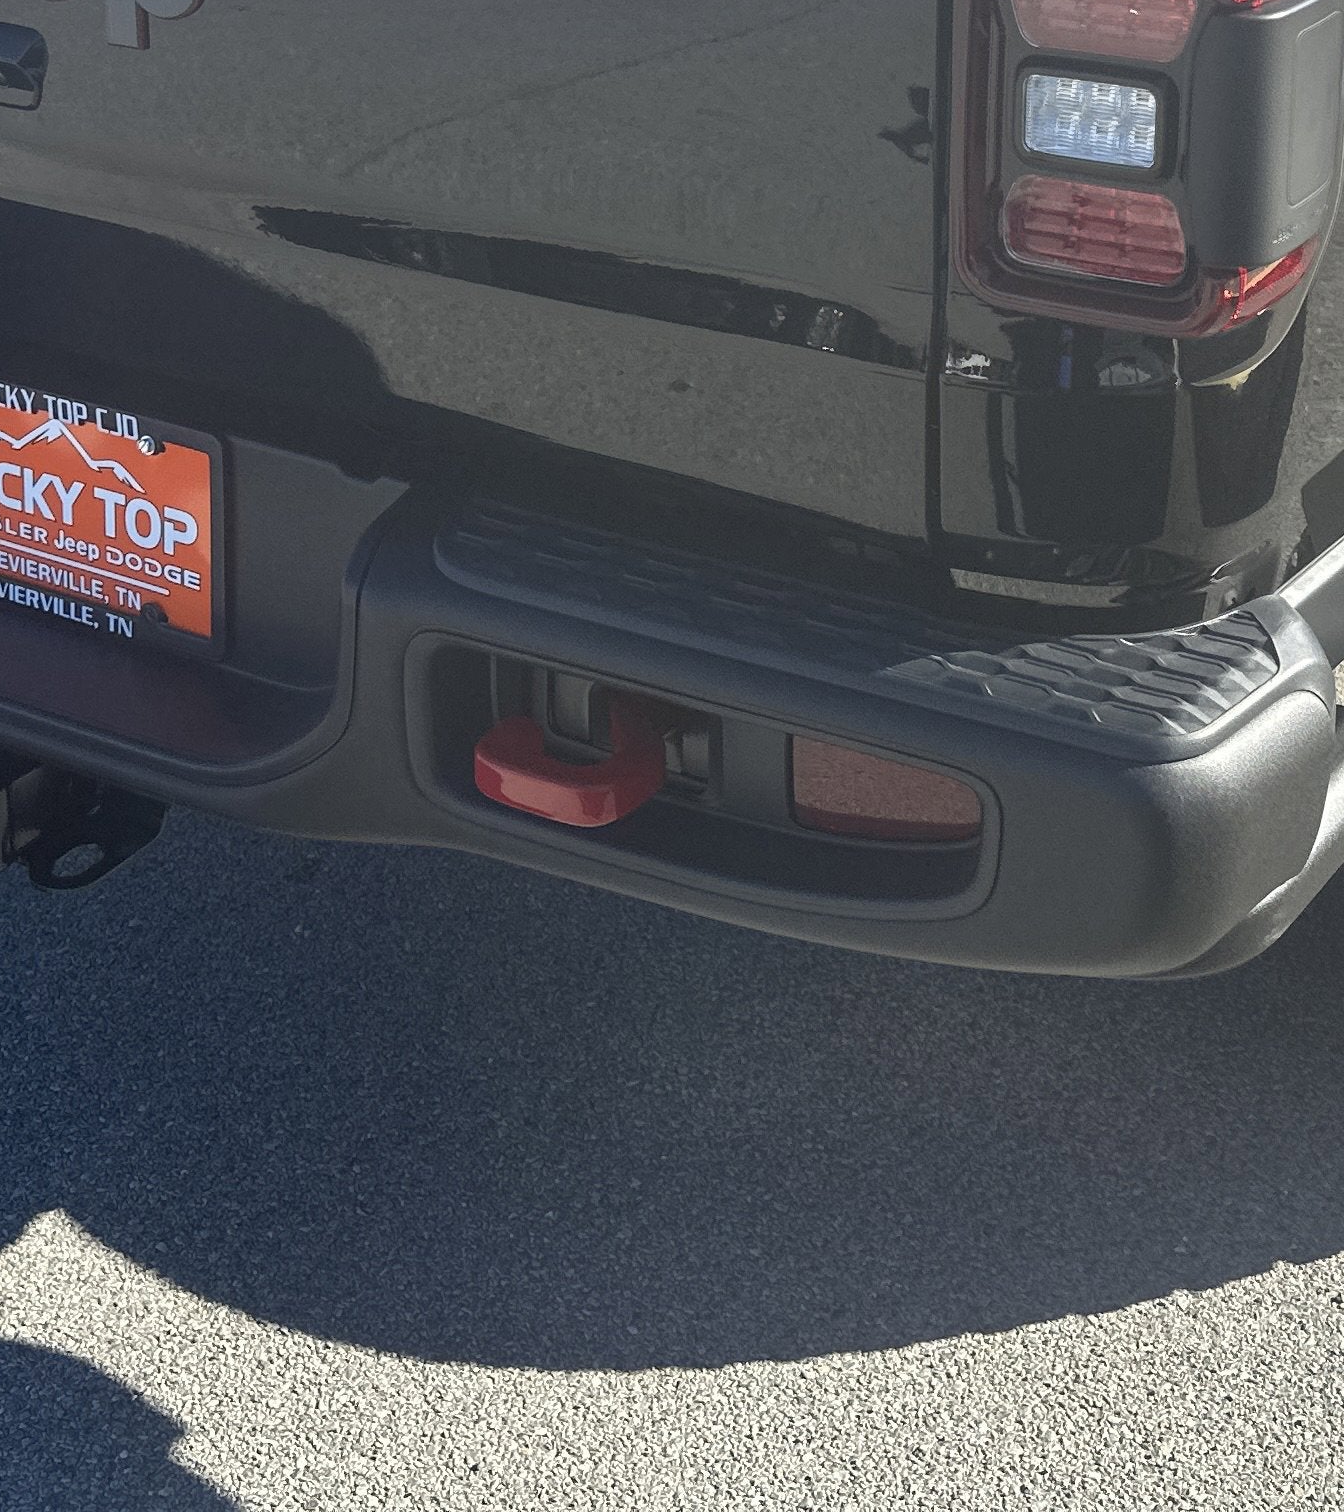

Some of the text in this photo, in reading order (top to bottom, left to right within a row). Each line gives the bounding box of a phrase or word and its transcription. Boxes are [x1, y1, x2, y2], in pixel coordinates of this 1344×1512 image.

[43, 393, 88, 426] TOP
[96, 408, 139, 440] CJD
[94, 486, 199, 556] TOP
[54, 529, 100, 561] Jeep
[105, 548, 201, 591] DODGE
[114, 586, 142, 611] TN
[105, 611, 134, 639] TN
